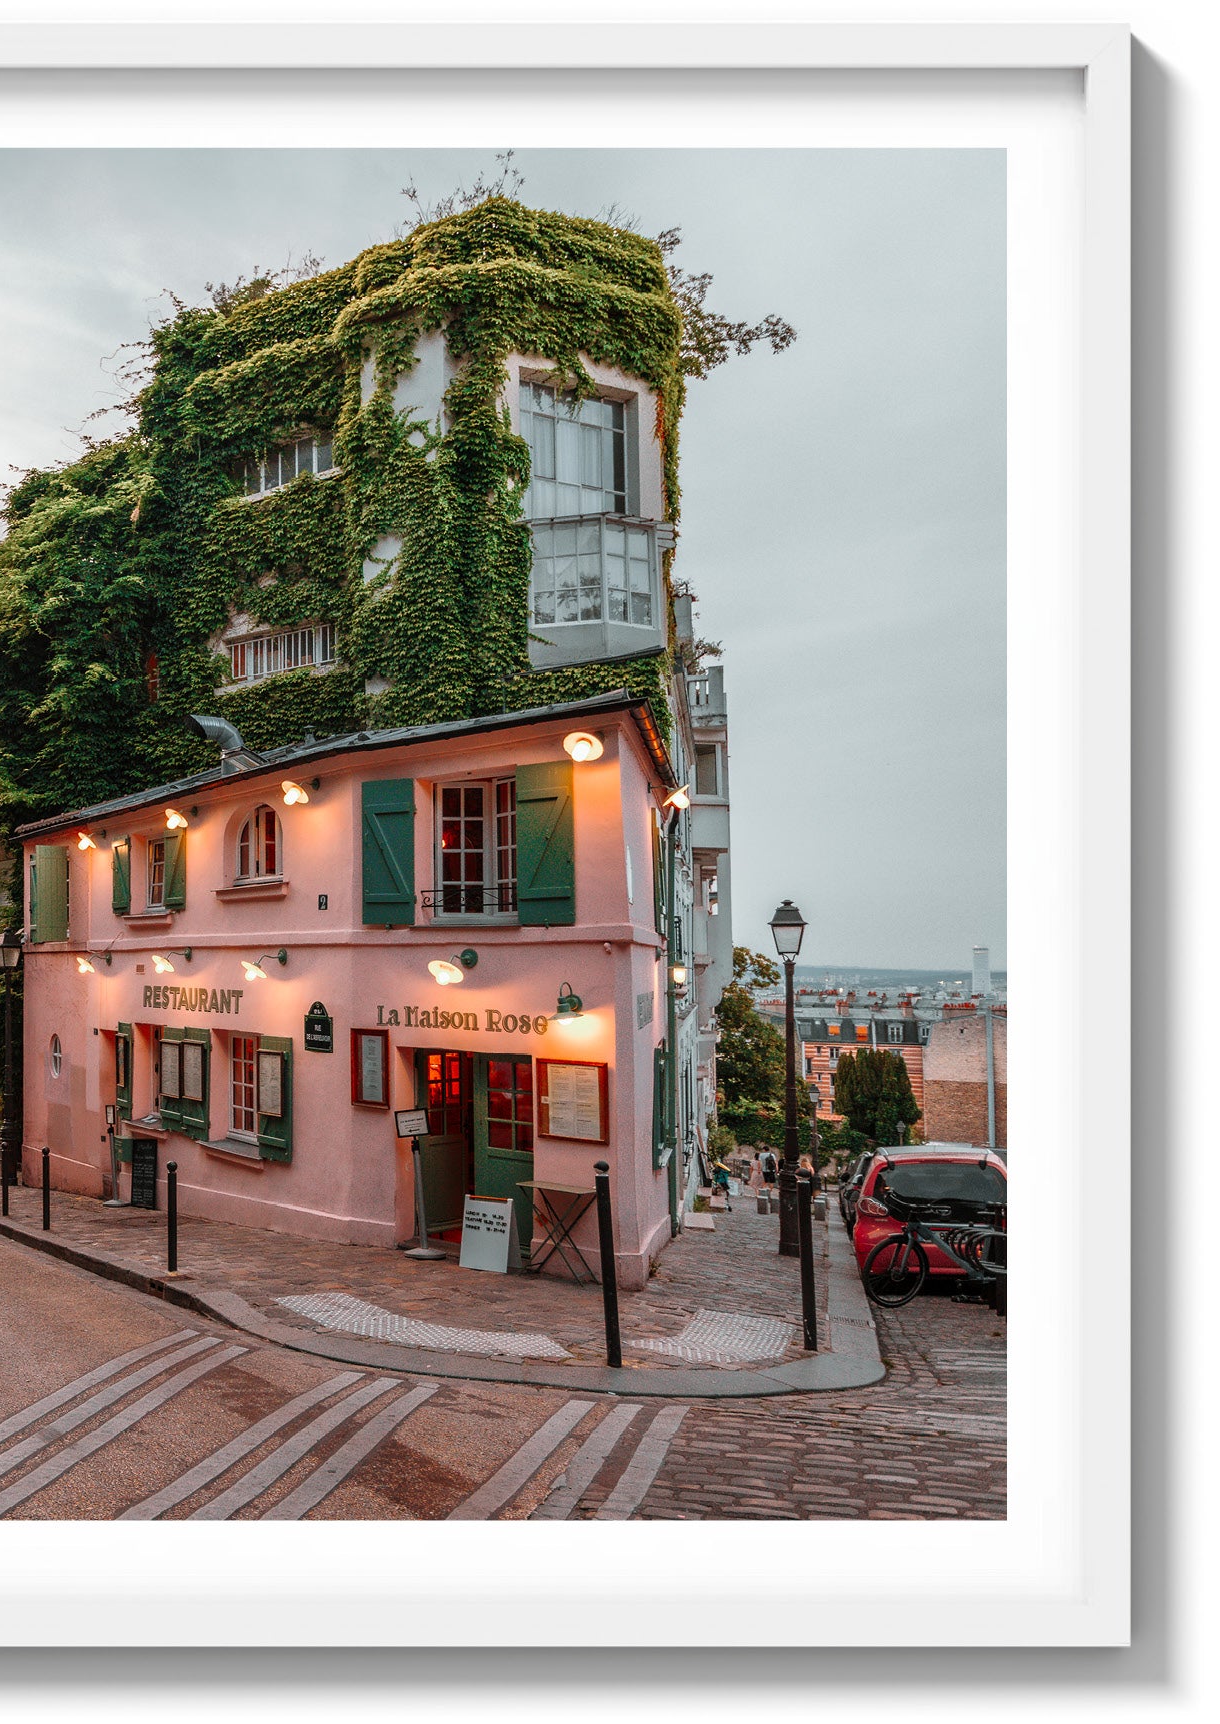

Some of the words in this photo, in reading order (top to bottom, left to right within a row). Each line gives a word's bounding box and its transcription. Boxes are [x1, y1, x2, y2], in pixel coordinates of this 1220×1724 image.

[320, 896, 326, 909] 2
[143, 985, 243, 1014] RESTAURANT
[376, 1005, 400, 1026] La
[404, 1006, 479, 1031] Maison
[485, 1009, 548, 1035] Rose
